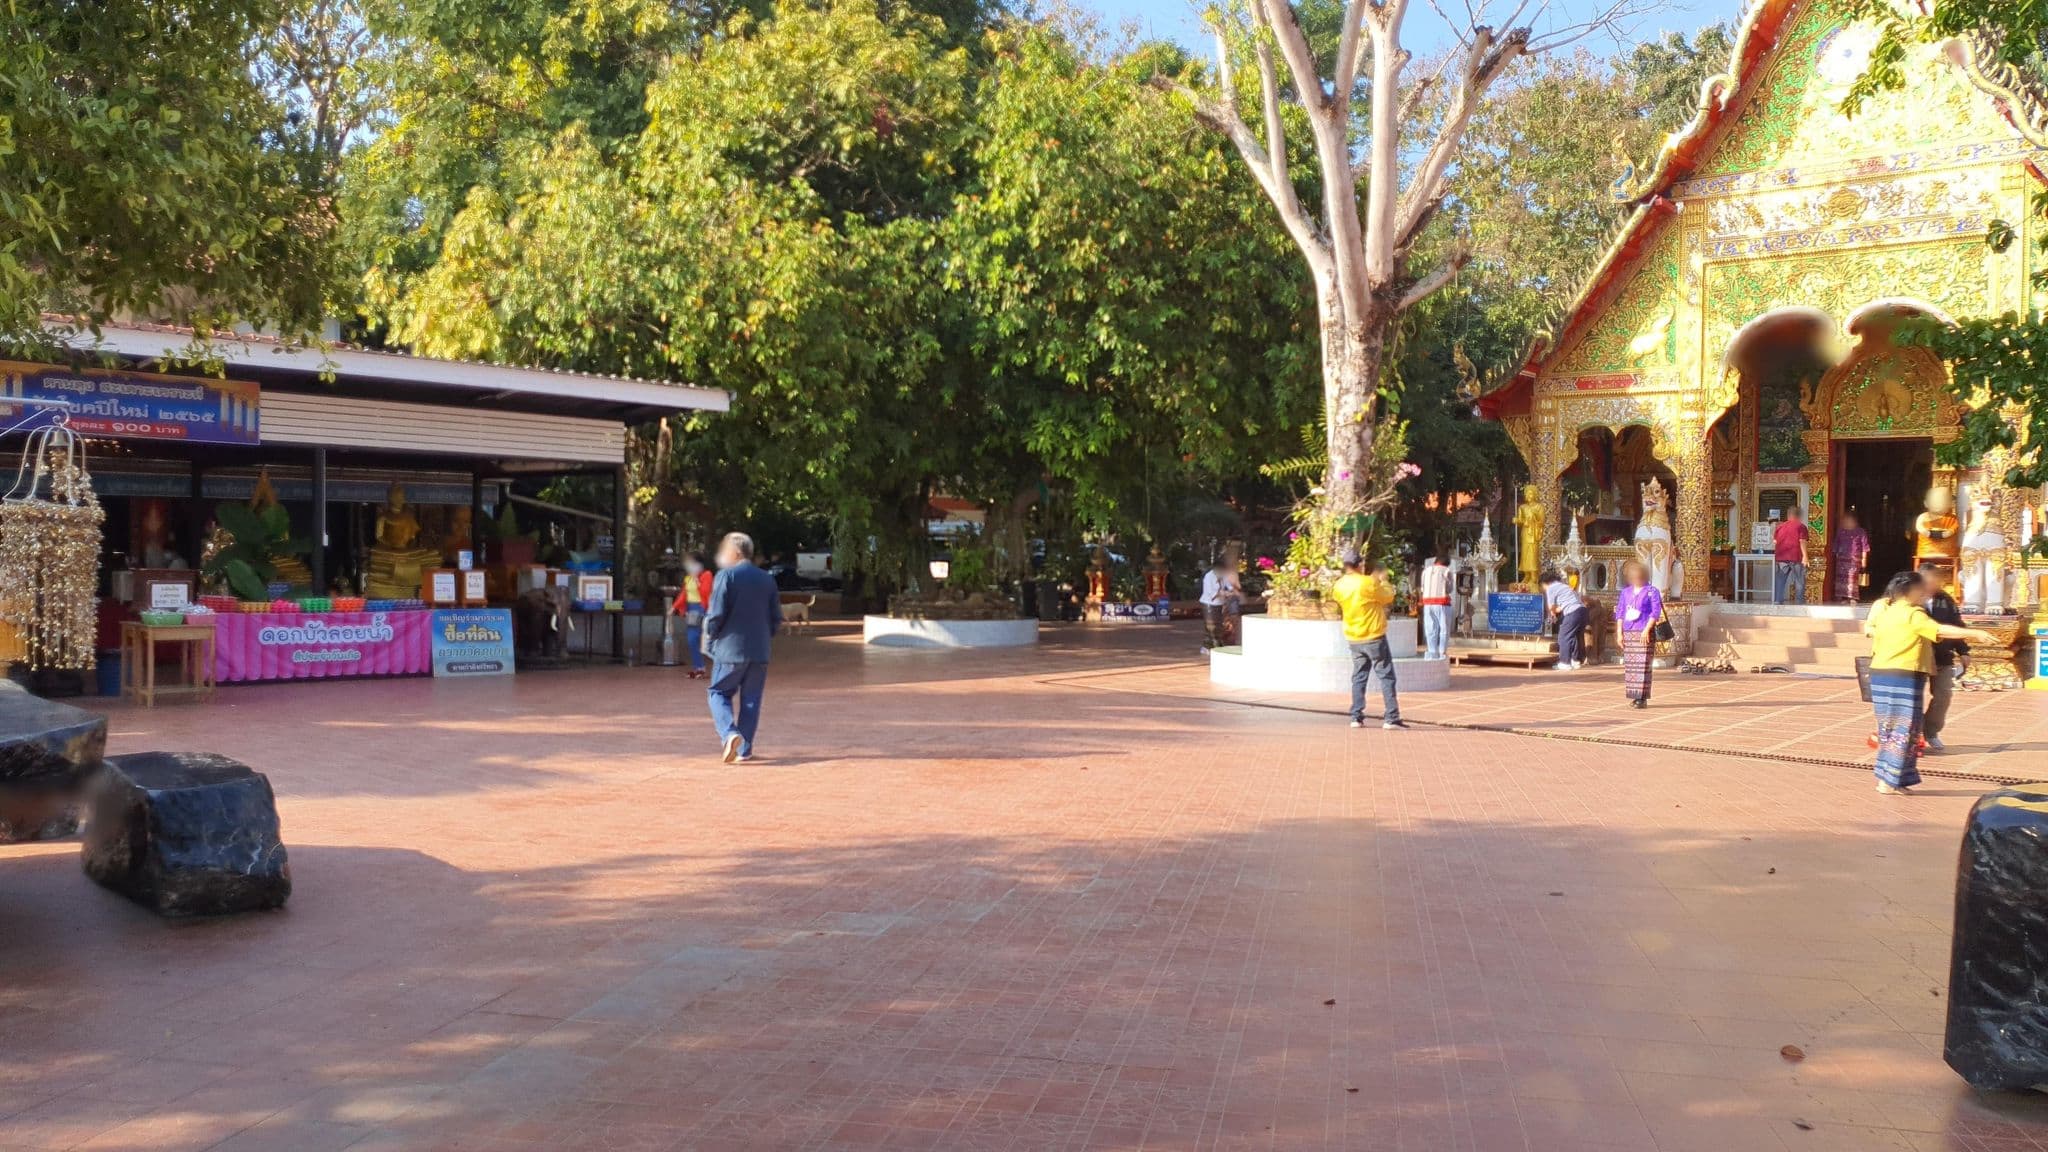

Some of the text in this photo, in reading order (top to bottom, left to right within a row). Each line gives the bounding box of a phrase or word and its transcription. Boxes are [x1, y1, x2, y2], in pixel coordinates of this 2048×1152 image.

[159, 409, 216, 423] ๒๕๖๕
[71, 420, 180, 434] ชุดละ ๑๐๐ บาท
[439, 614, 505, 624] ขอเชิญร่วมบริจาค
[261, 614, 392, 643] ดอกบัวลอยน้ำ
[445, 623, 502, 642] ซื้อที่ดิน
[294, 649, 360, 662] สีประจำวันเกิด
